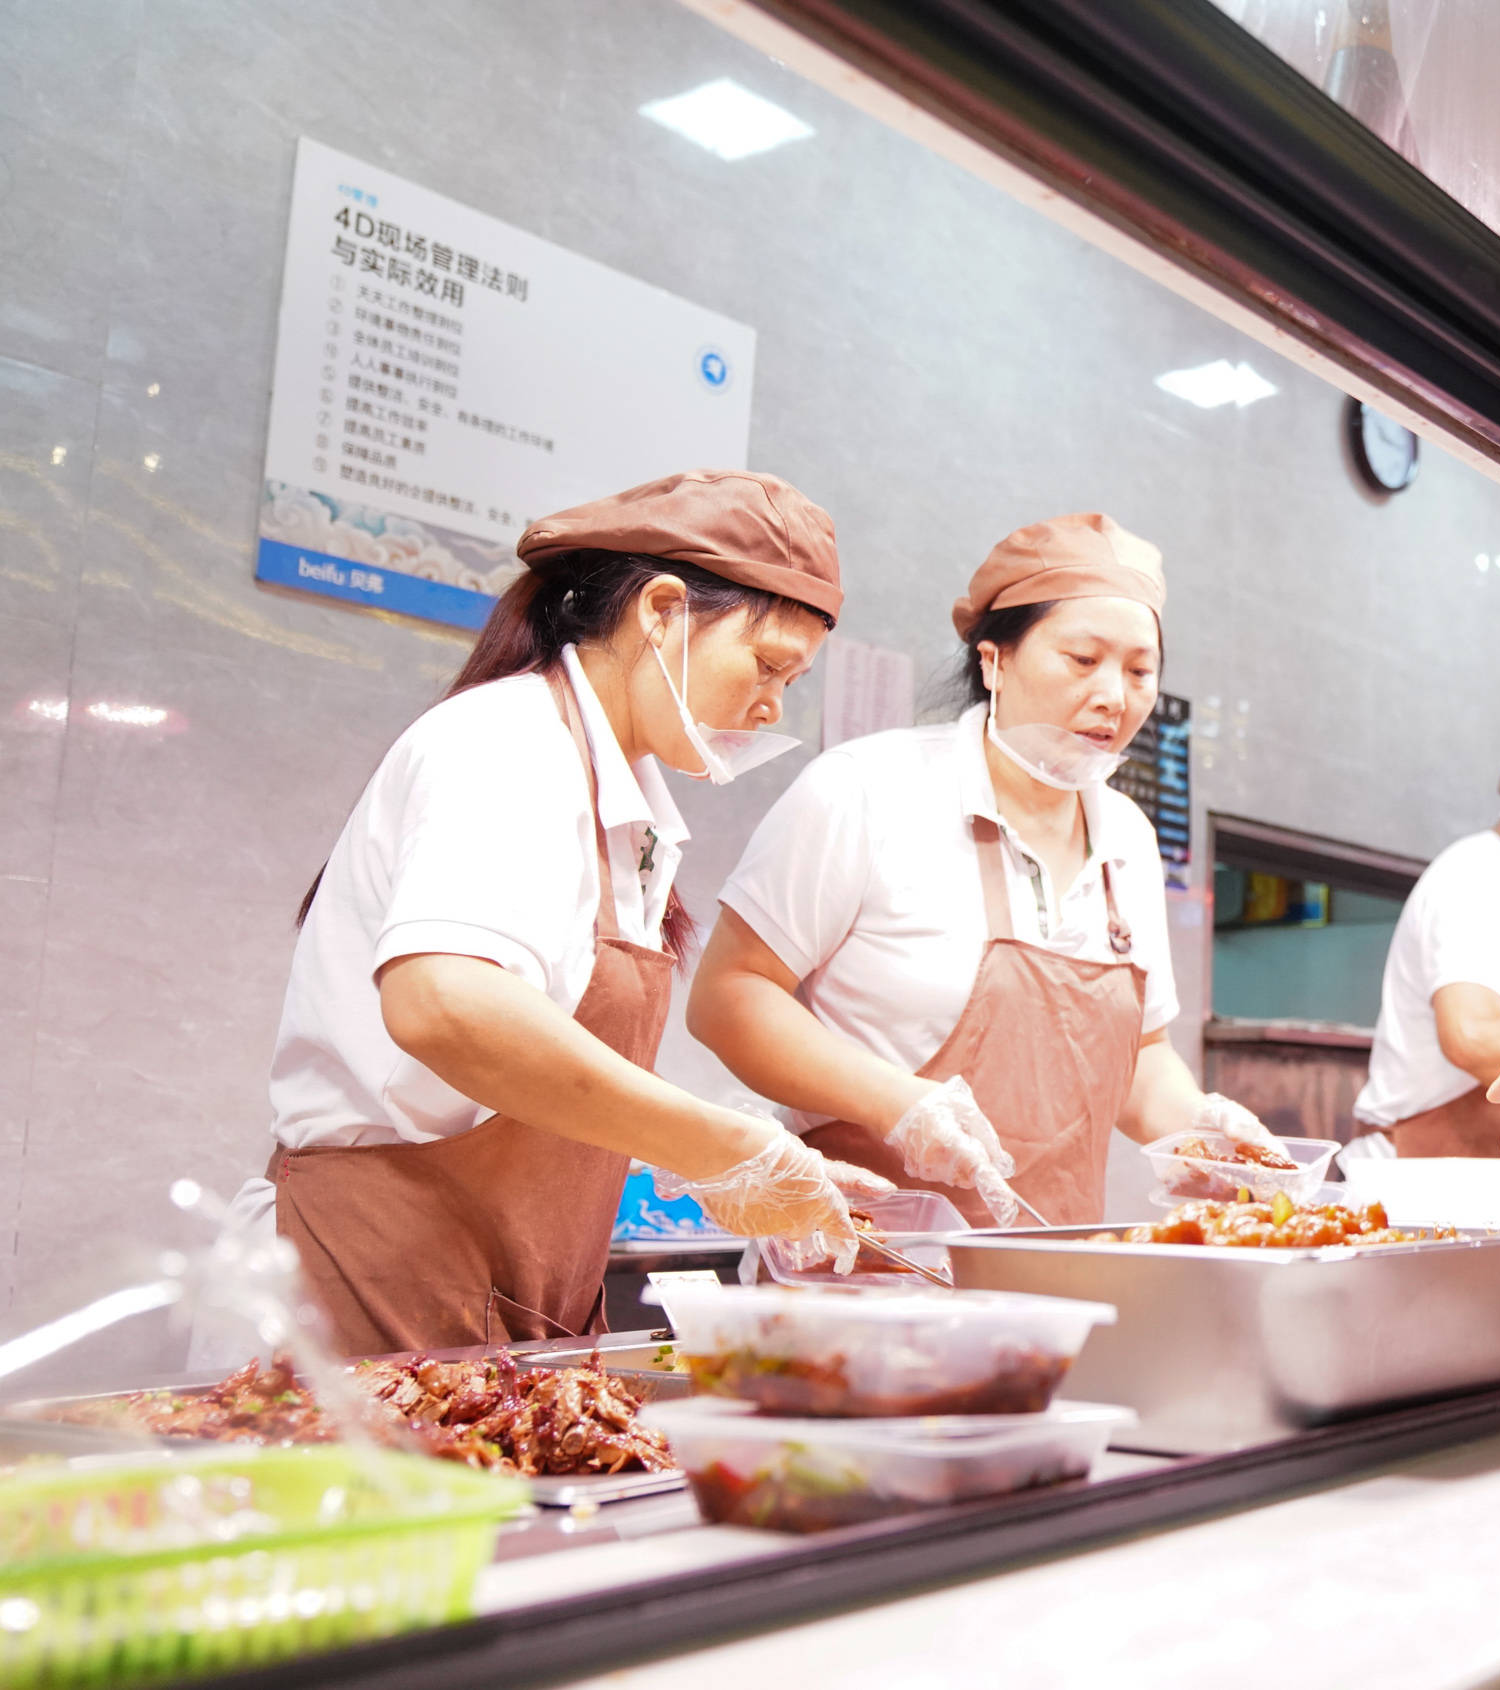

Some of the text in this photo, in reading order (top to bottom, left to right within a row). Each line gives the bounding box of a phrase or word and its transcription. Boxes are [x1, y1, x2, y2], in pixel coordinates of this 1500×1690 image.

[331, 235, 465, 309] 与实际效用
[334, 206, 529, 303] 4D现场管理法则
[298, 556, 345, 586] beifu
